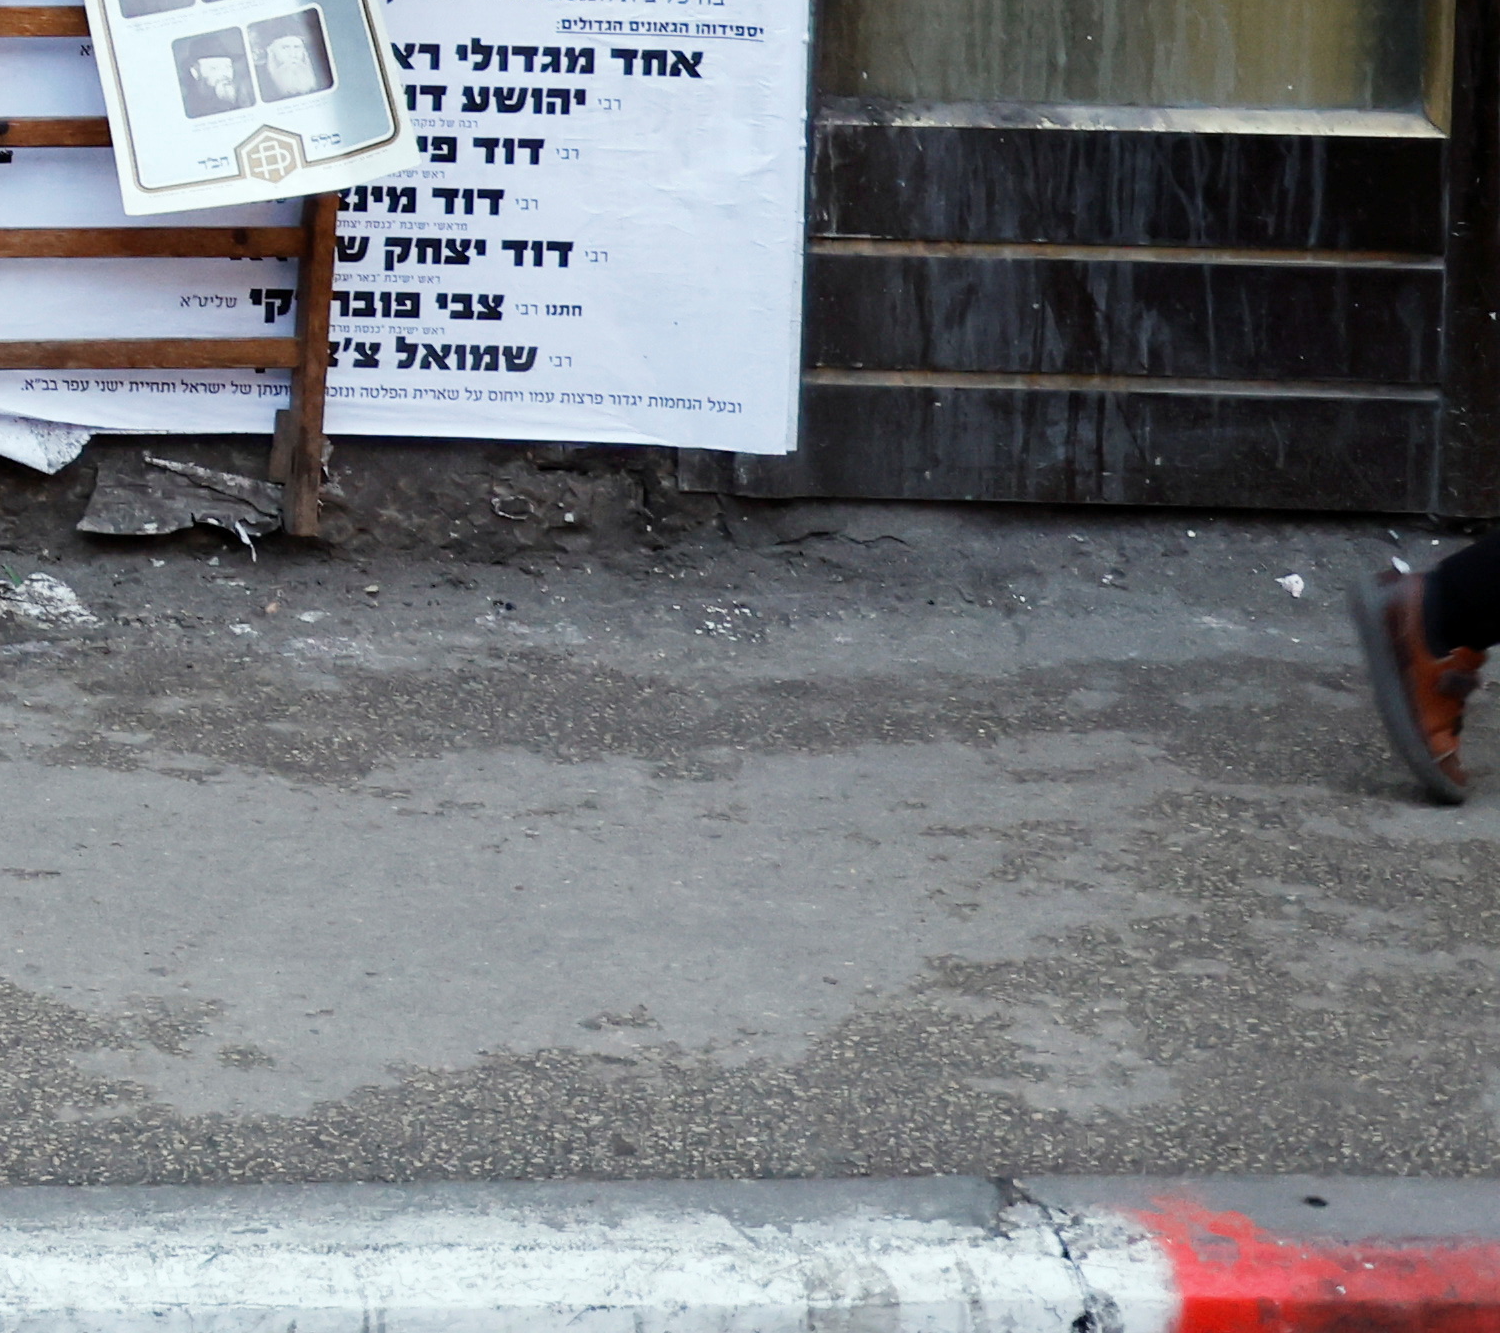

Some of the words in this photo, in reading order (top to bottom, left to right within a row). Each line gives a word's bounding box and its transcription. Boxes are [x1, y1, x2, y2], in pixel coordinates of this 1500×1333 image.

[455, 36, 595, 76] מגדולי
[610, 47, 704, 80] אחד
[472, 137, 546, 167] דוד
[555, 146, 580, 161] רבי
[383, 236, 487, 272] יצחק
[501, 239, 575, 269] דוד
[583, 247, 609, 264] רבי
[435, 291, 506, 322] צבי
[514, 301, 540, 317] רבי
[545, 303, 583, 318] חתנו
